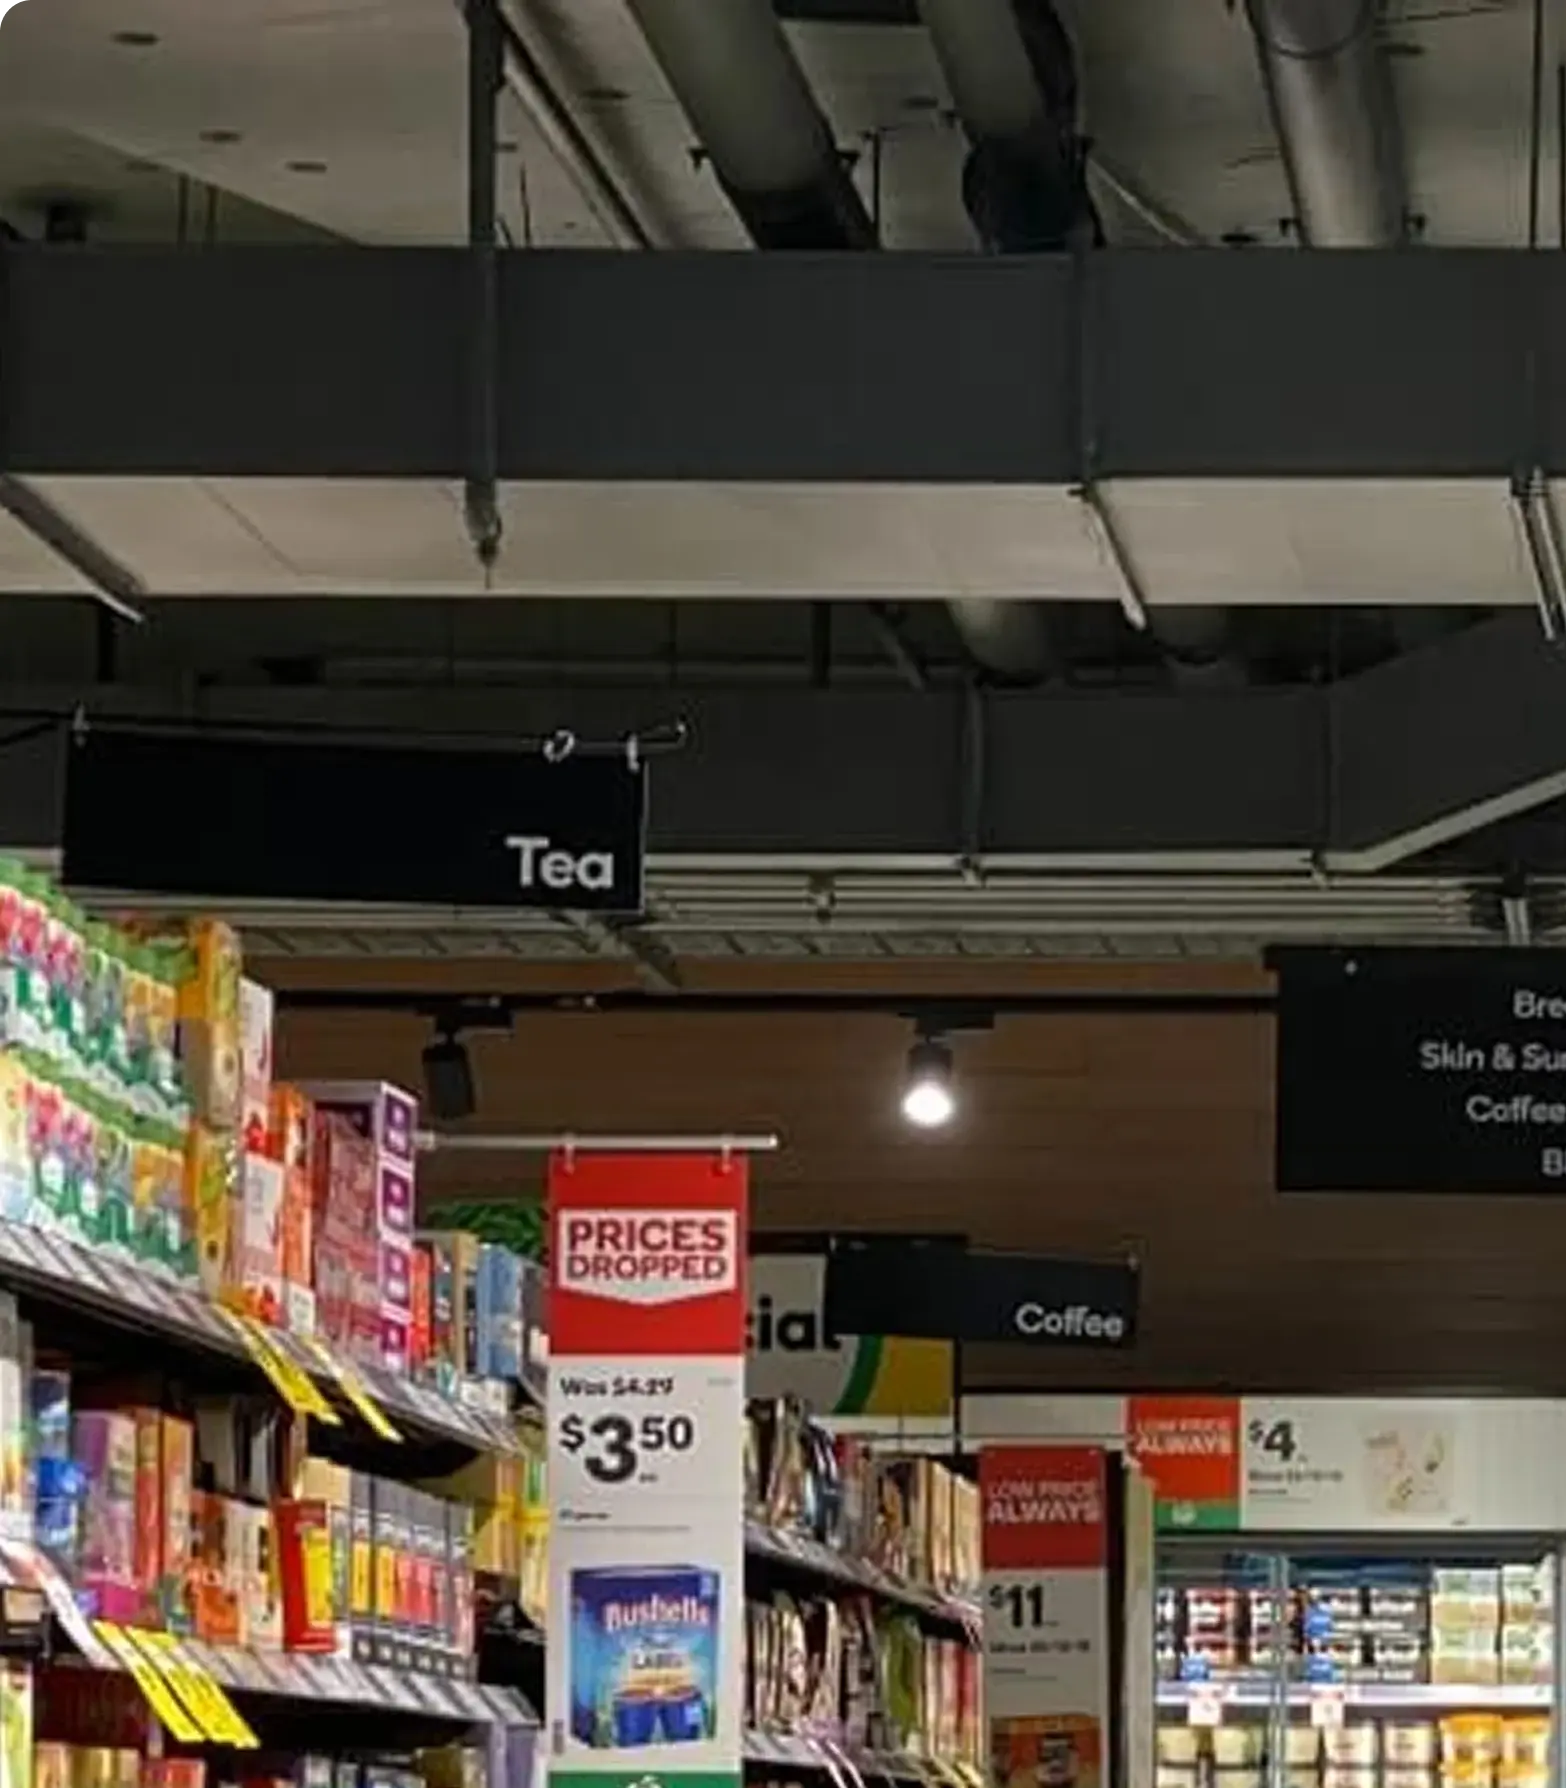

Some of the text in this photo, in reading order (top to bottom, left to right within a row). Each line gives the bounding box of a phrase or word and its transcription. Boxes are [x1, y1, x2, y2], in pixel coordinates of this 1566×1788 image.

[505, 836, 614, 889] Tea
[1420, 1041, 1485, 1070] Skin
[1492, 1043, 1516, 1070] &
[1465, 1094, 1566, 1123] Coffee
[568, 1218, 727, 1252] PRICES
[567, 1254, 728, 1280] DROPPED
[1014, 1302, 1125, 1338] Coffee
[985, 1500, 1101, 1526] ALWAYS
